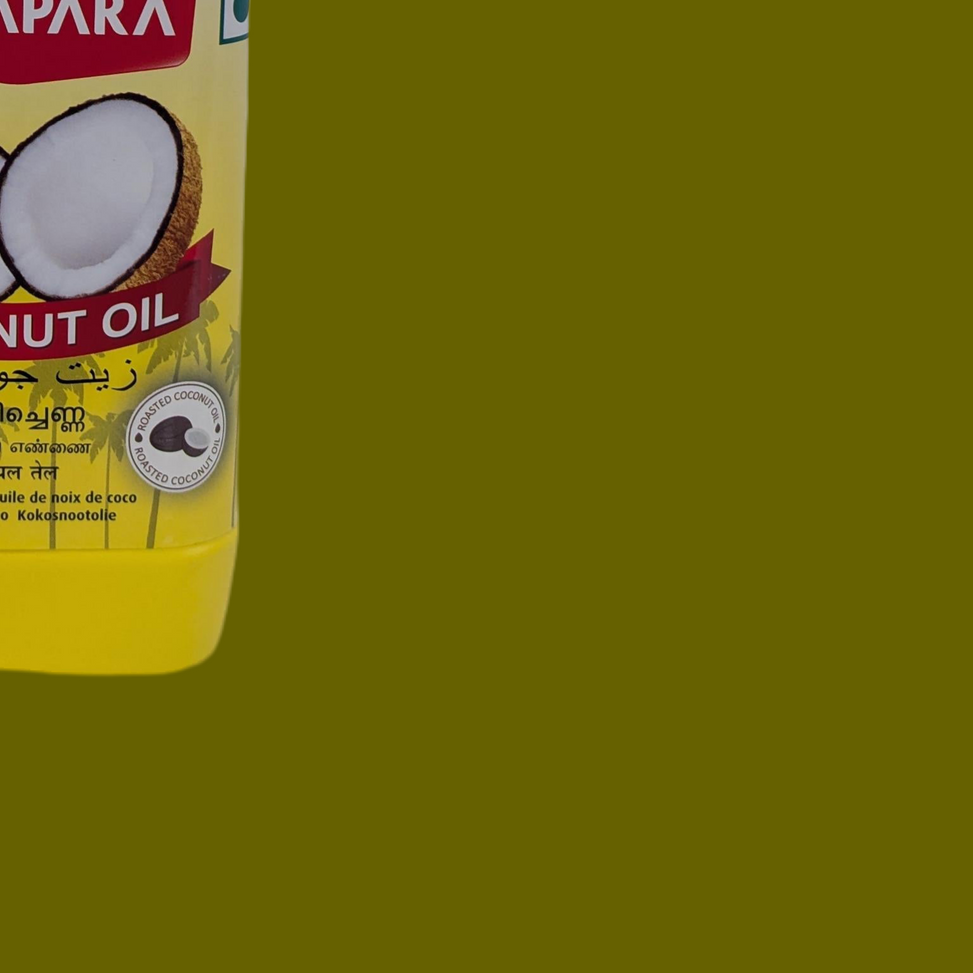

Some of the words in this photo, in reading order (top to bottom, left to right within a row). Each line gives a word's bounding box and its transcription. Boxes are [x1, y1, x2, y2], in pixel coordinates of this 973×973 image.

[102, 292, 179, 338] OIL
[56, 358, 137, 391] زيت
[137, 395, 172, 431] ROASTED
[174, 390, 214, 409] COCONUT
[210, 407, 220, 423] OIL
[30, 460, 60, 481] तेल
[135, 447, 168, 483] ROASTED
[171, 456, 213, 485] COCONUT
[211, 438, 220, 454] OIL
[29, 491, 46, 503] de
[51, 491, 80, 504] noix
[85, 492, 103, 504] de
[107, 494, 137, 504] coco
[17, 508, 117, 521] Kokosnootolie
